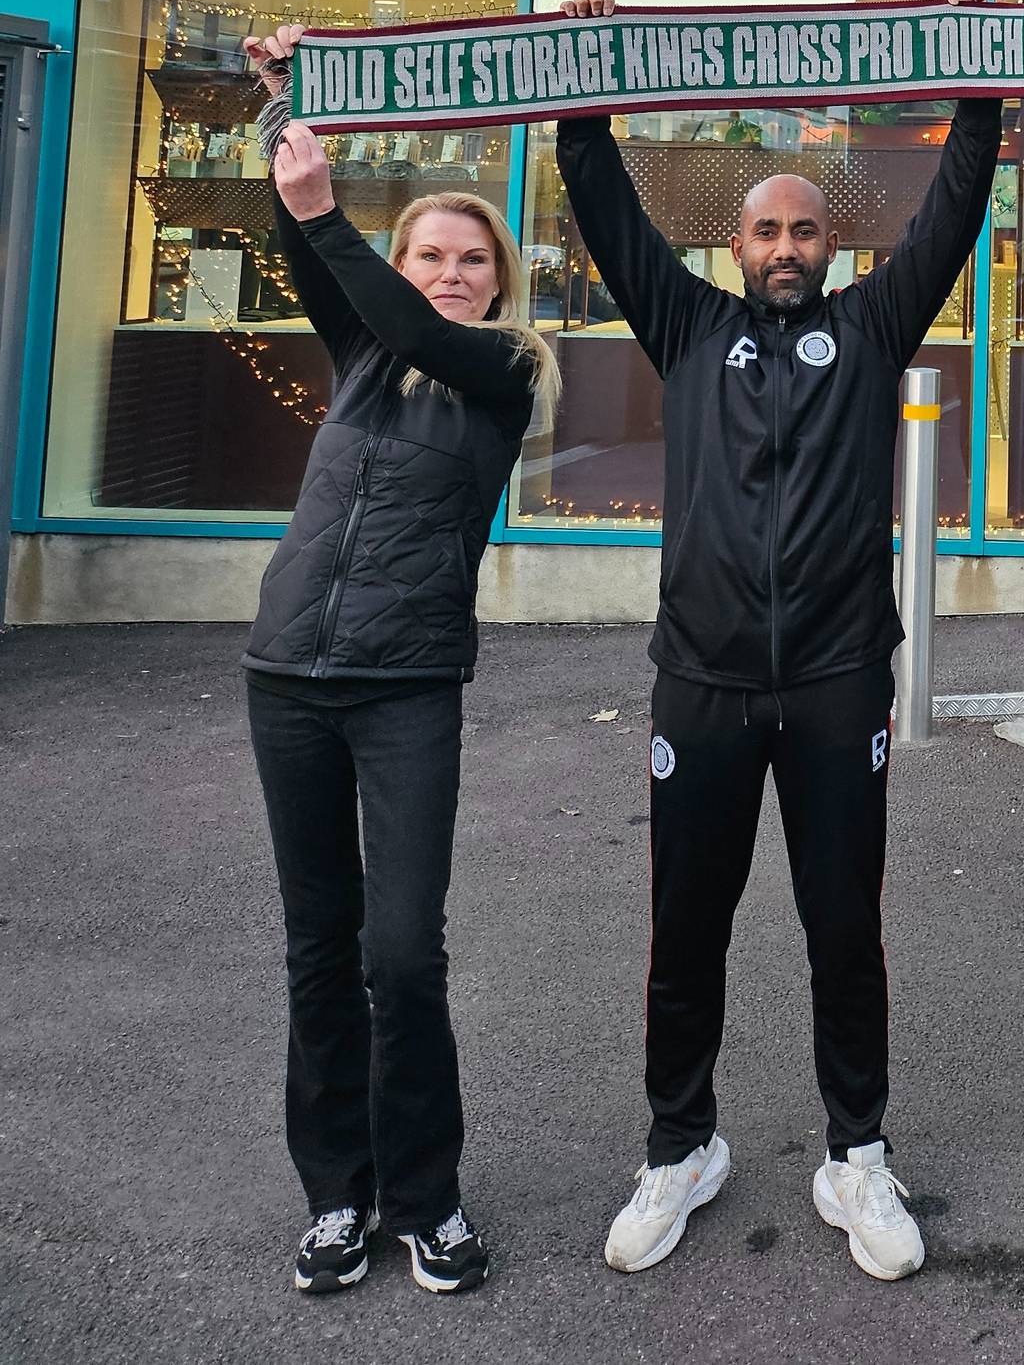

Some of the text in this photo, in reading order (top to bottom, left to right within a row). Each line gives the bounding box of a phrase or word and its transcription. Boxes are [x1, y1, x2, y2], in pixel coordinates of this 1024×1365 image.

[300, 47, 385, 114] HOLD
[394, 42, 465, 109] SELF
[472, 29, 618, 104] STORAGE
[622, 26, 726, 90] KINGS
[732, 23, 847, 85] CROSS
[850, 20, 913, 82] PRO
[920, 17, 1024, 77] TOUCH
